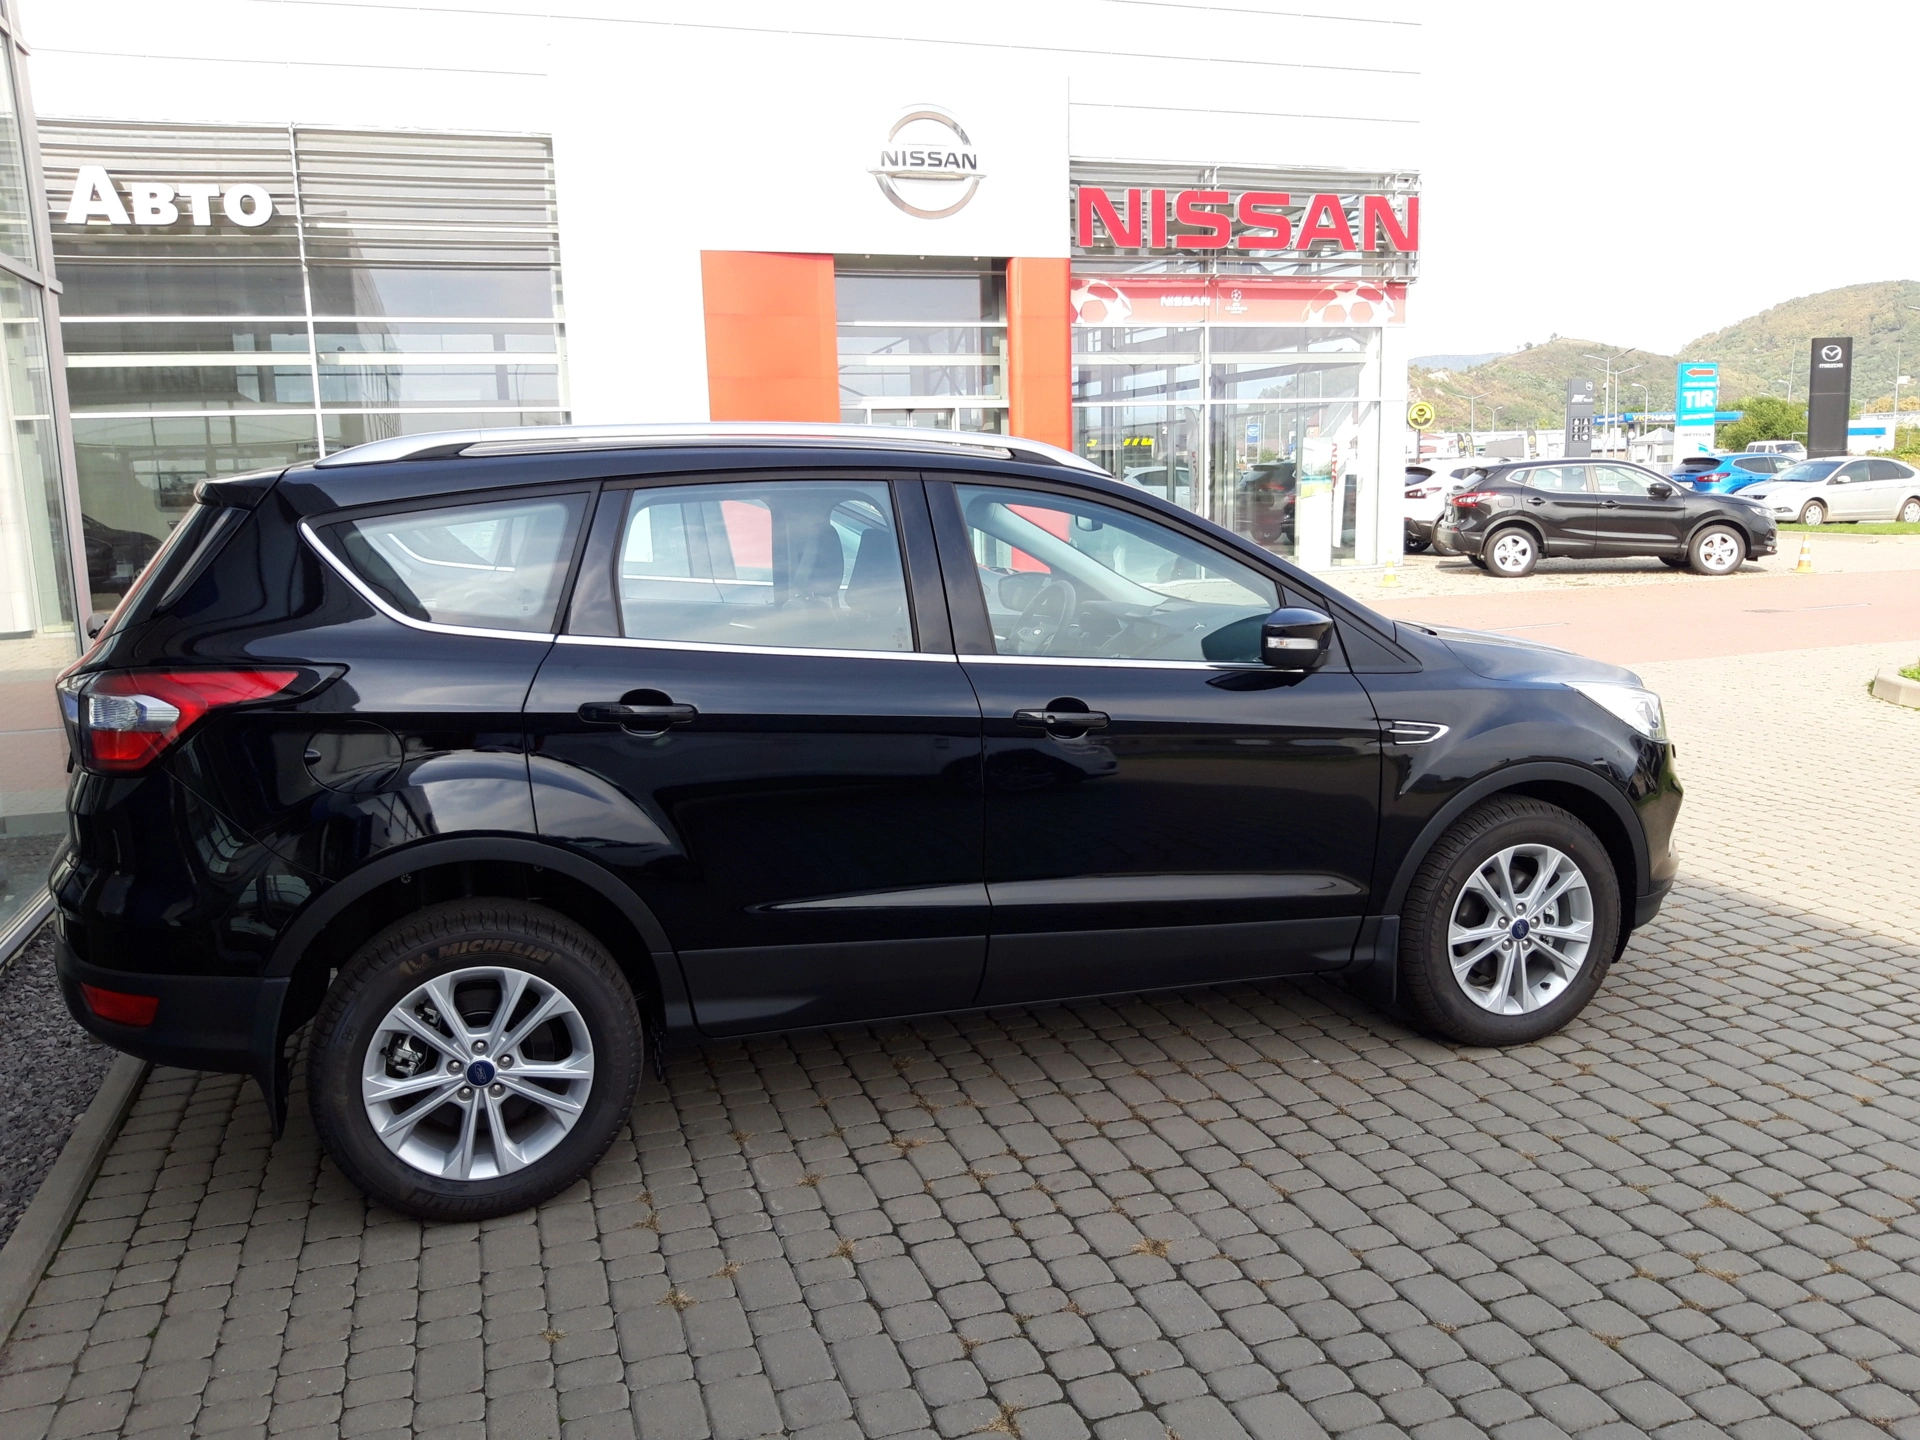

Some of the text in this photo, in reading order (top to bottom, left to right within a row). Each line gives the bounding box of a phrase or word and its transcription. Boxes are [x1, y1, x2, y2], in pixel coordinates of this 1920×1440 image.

[880, 150, 977, 171] NISSAN
[1076, 187, 1420, 252] NISSAN
[1159, 296, 1211, 307] NISSAN
[1682, 389, 1715, 409] TIR
[438, 938, 553, 963] MICHELIN
